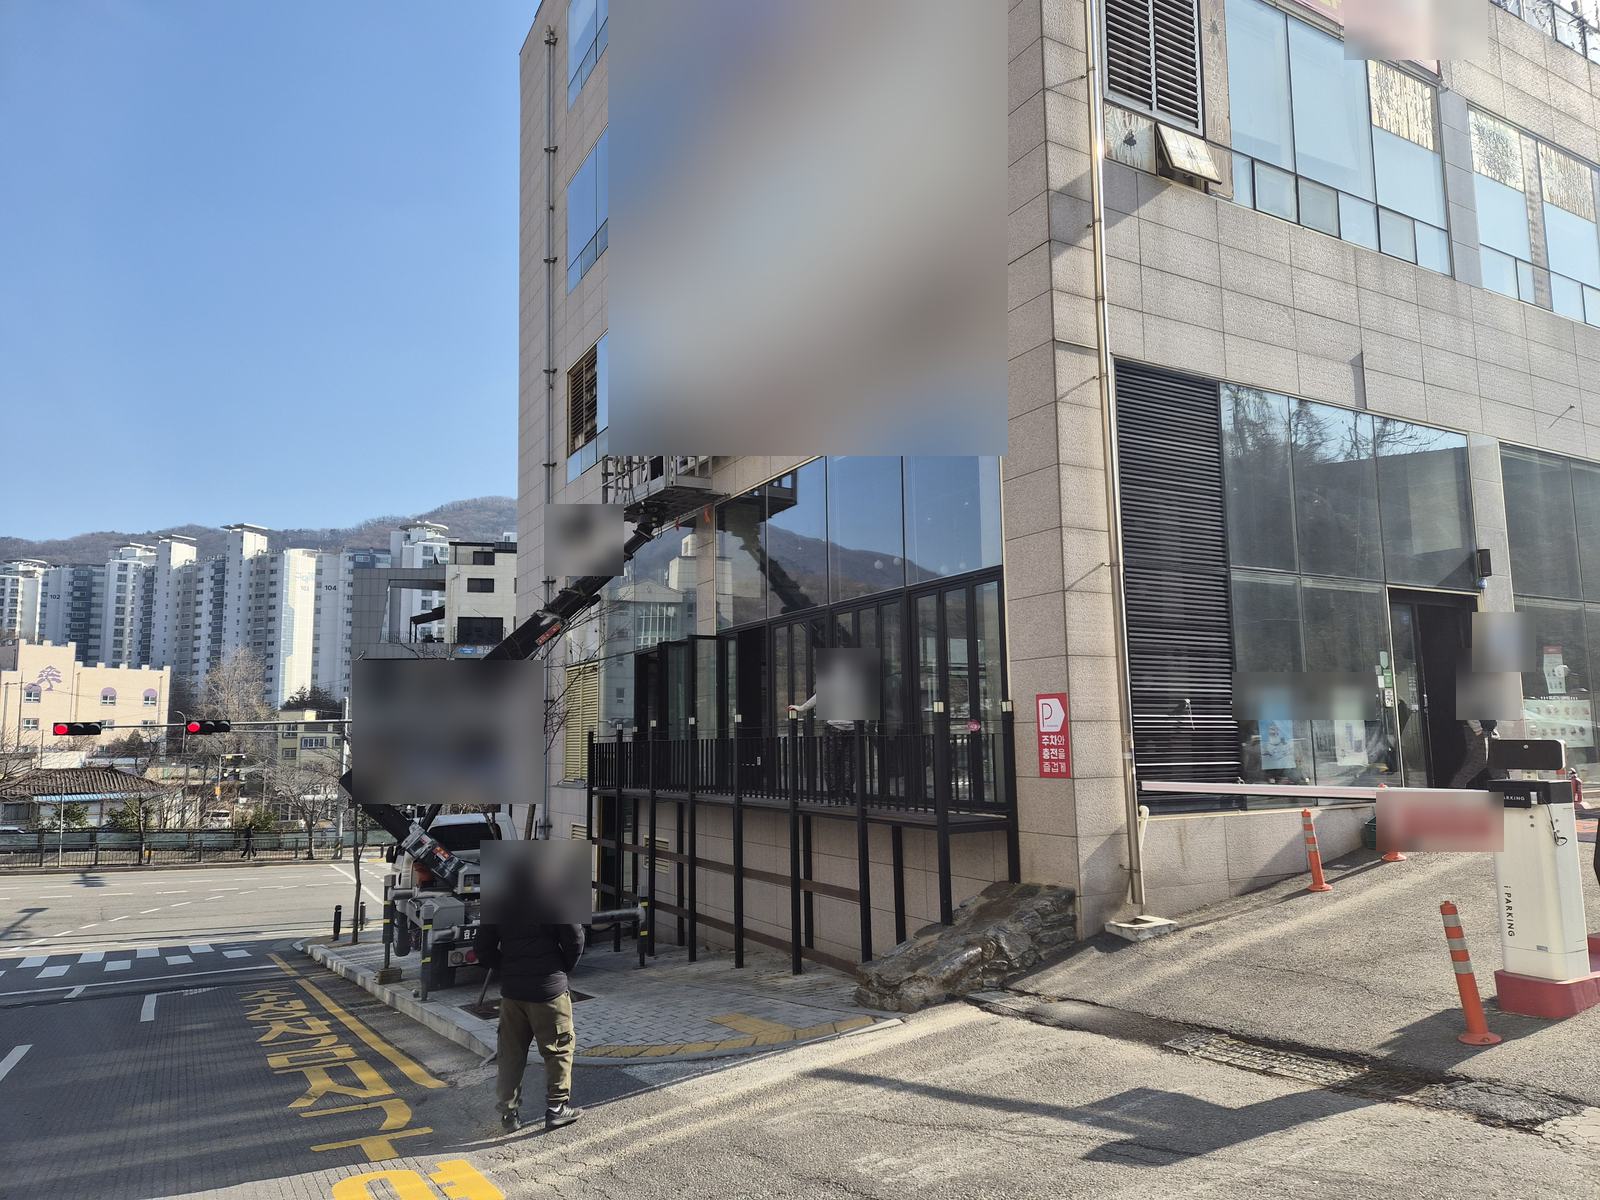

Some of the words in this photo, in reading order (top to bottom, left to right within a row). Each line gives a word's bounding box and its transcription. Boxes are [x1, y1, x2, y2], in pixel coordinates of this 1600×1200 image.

[1041, 734, 1065, 746] 주차와
[1042, 748, 1066, 760] 충전을
[1043, 761, 1067, 773] 즐겁게
